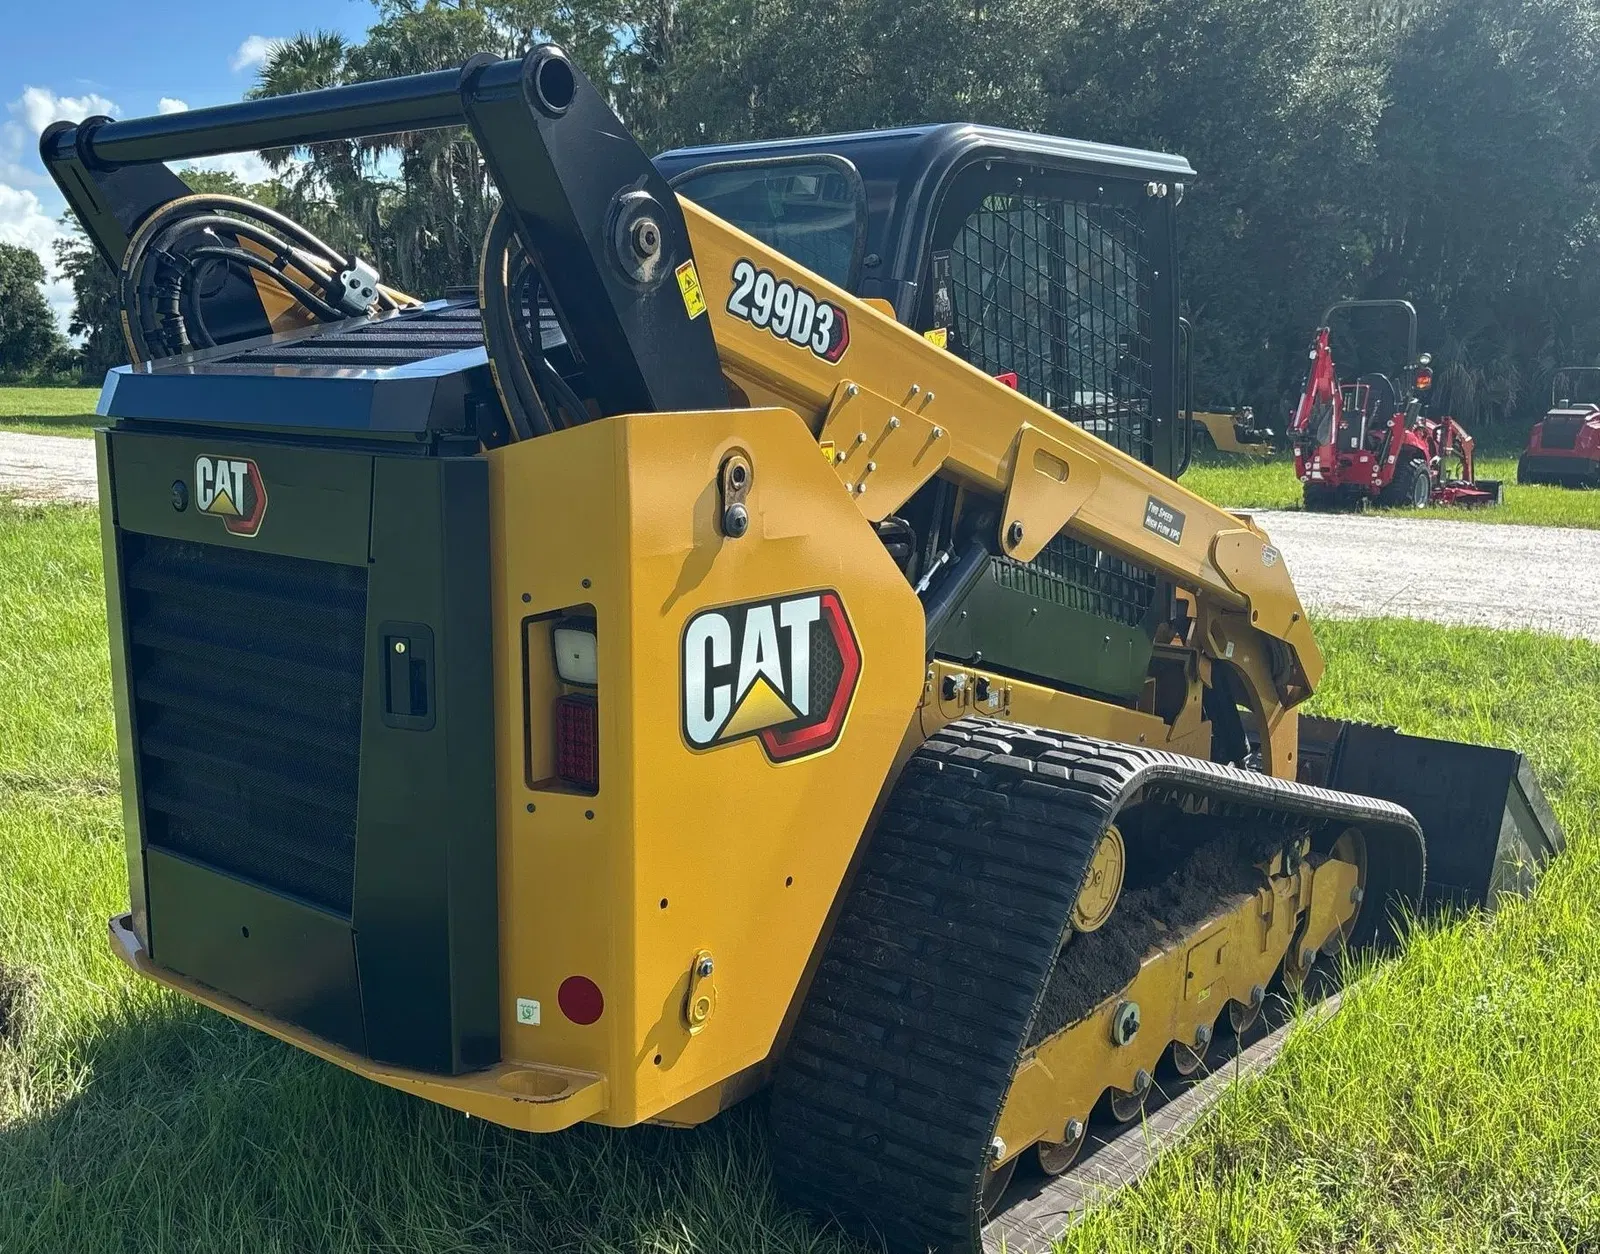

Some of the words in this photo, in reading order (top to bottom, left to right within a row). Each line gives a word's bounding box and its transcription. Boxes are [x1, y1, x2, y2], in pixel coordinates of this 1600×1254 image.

[728, 262, 834, 354] 299D3
[196, 457, 248, 516] CAT
[685, 595, 821, 744] CAT
